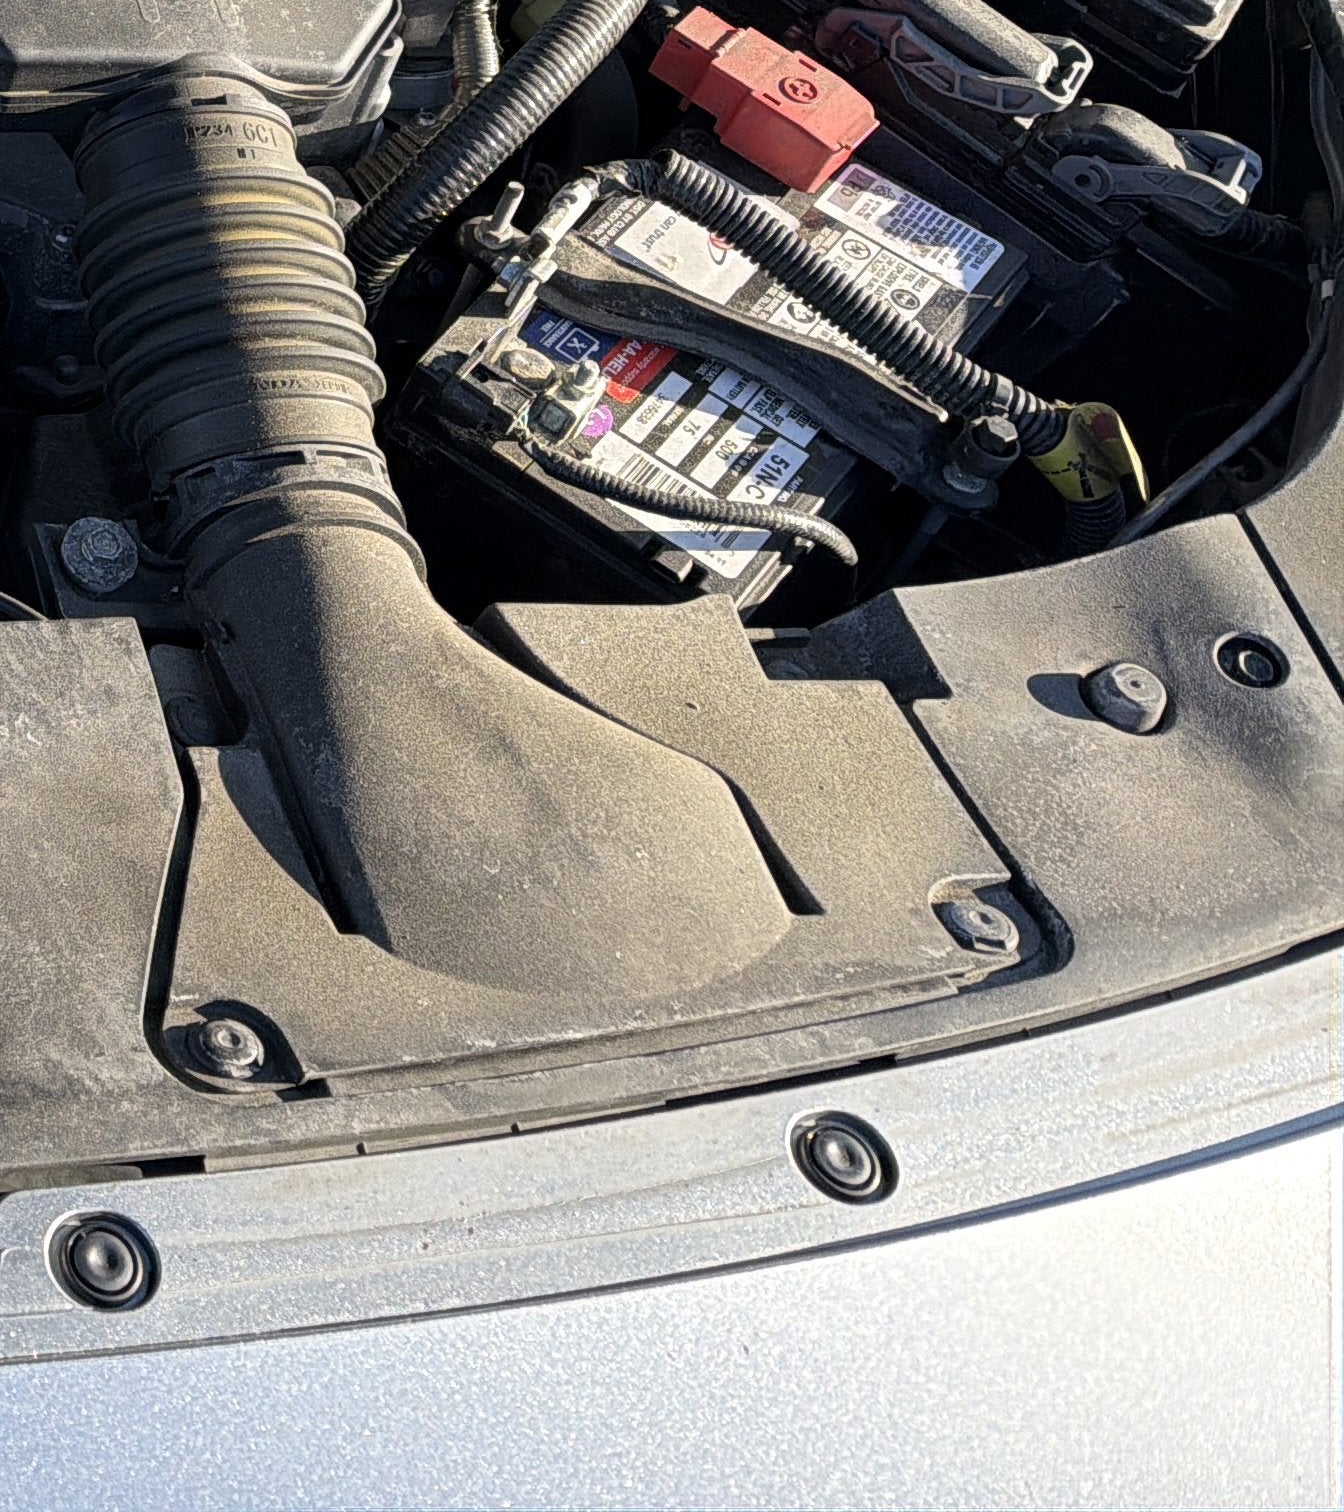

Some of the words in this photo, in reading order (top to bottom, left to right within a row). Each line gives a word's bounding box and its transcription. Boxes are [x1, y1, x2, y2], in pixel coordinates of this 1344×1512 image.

[658, 213, 679, 231] can
[639, 227, 667, 251] trust
[680, 418, 702, 437] 75
[713, 437, 739, 462] 500
[742, 452, 791, 503] 51N-C
